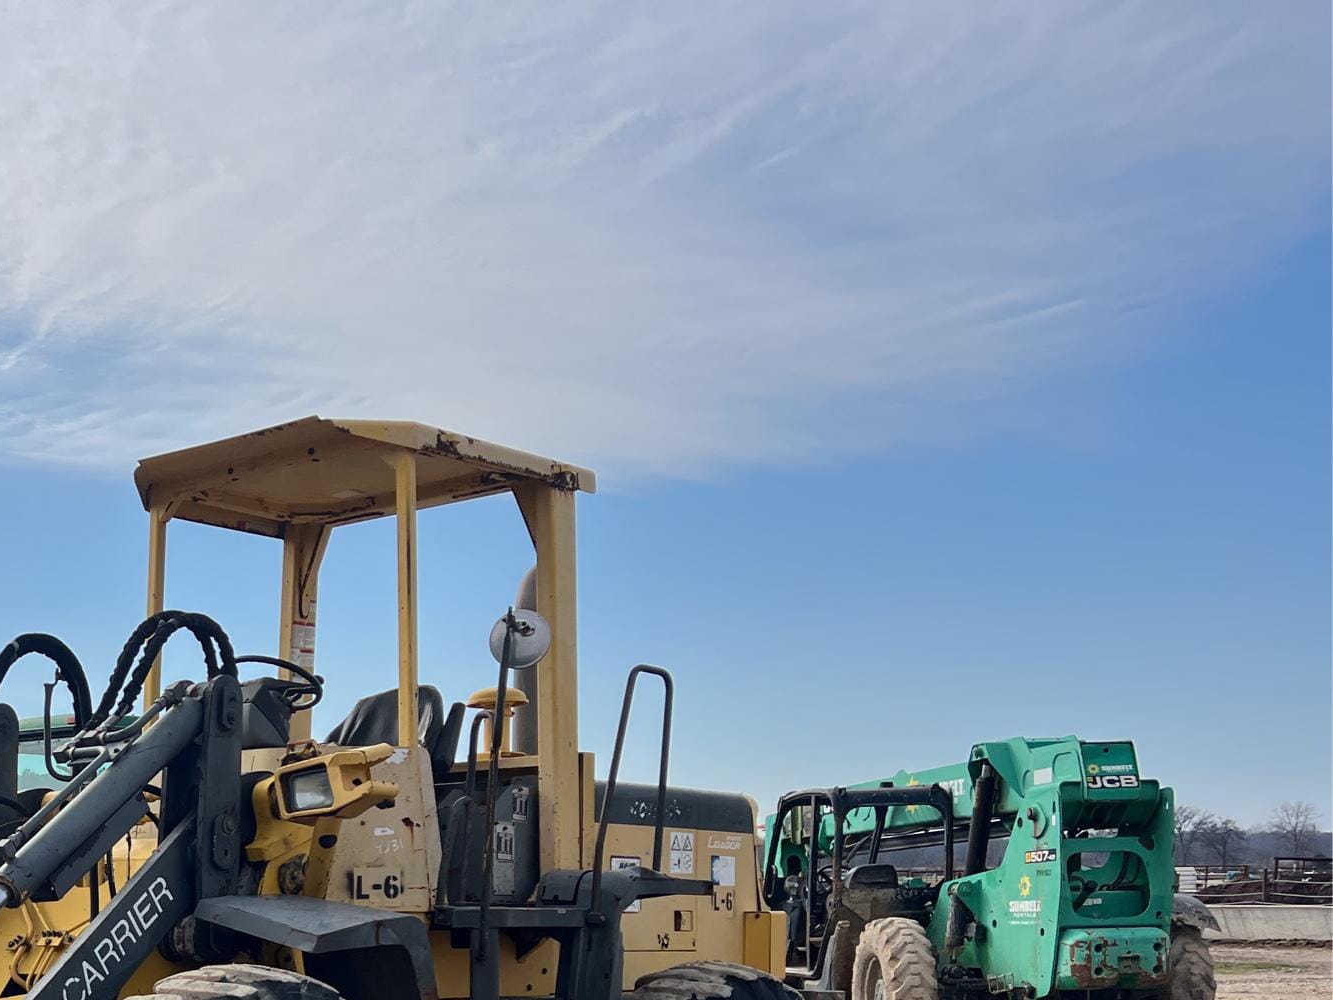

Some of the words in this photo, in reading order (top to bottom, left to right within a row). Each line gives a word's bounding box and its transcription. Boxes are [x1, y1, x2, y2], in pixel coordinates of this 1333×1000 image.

[1087, 775, 1139, 788] JCB
[356, 874, 399, 899] L-6
[713, 891, 733, 912] L-6
